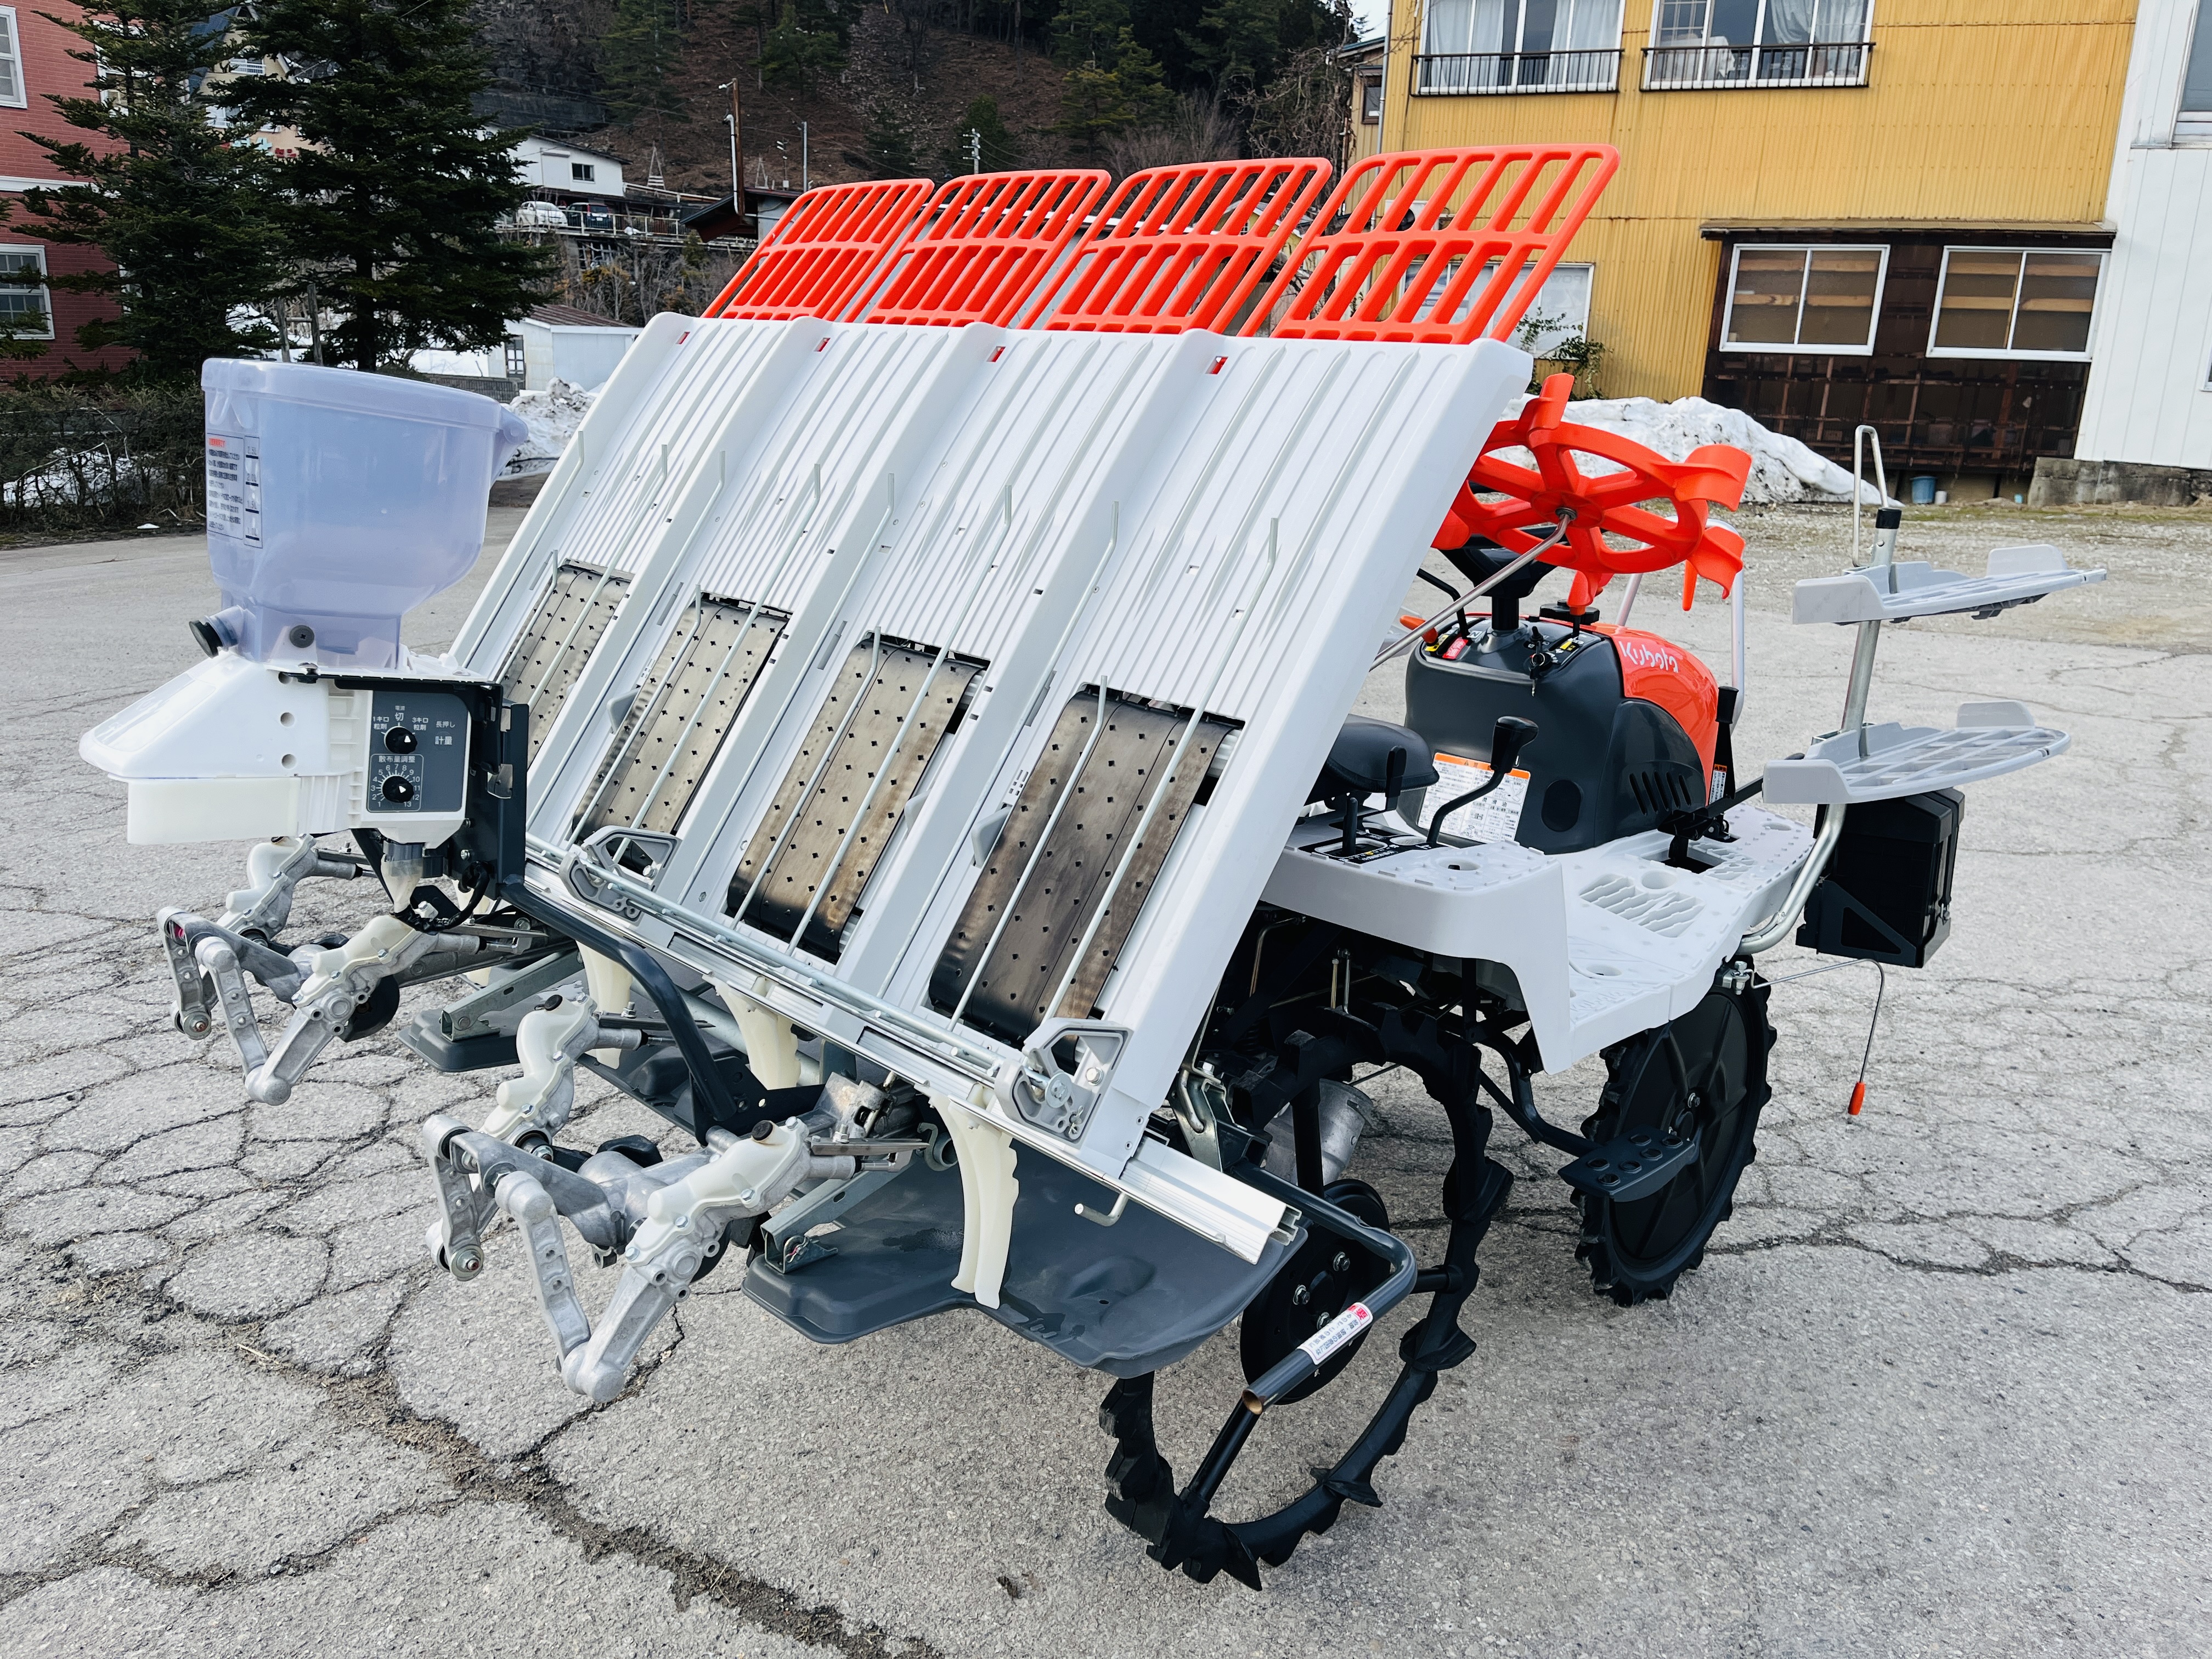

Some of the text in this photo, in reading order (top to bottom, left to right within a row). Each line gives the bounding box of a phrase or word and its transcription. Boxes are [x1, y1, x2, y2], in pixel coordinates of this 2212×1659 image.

[1618, 641, 1679, 673] Kubota
[395, 712, 404, 721] 切
[435, 736, 452, 746] 計量
